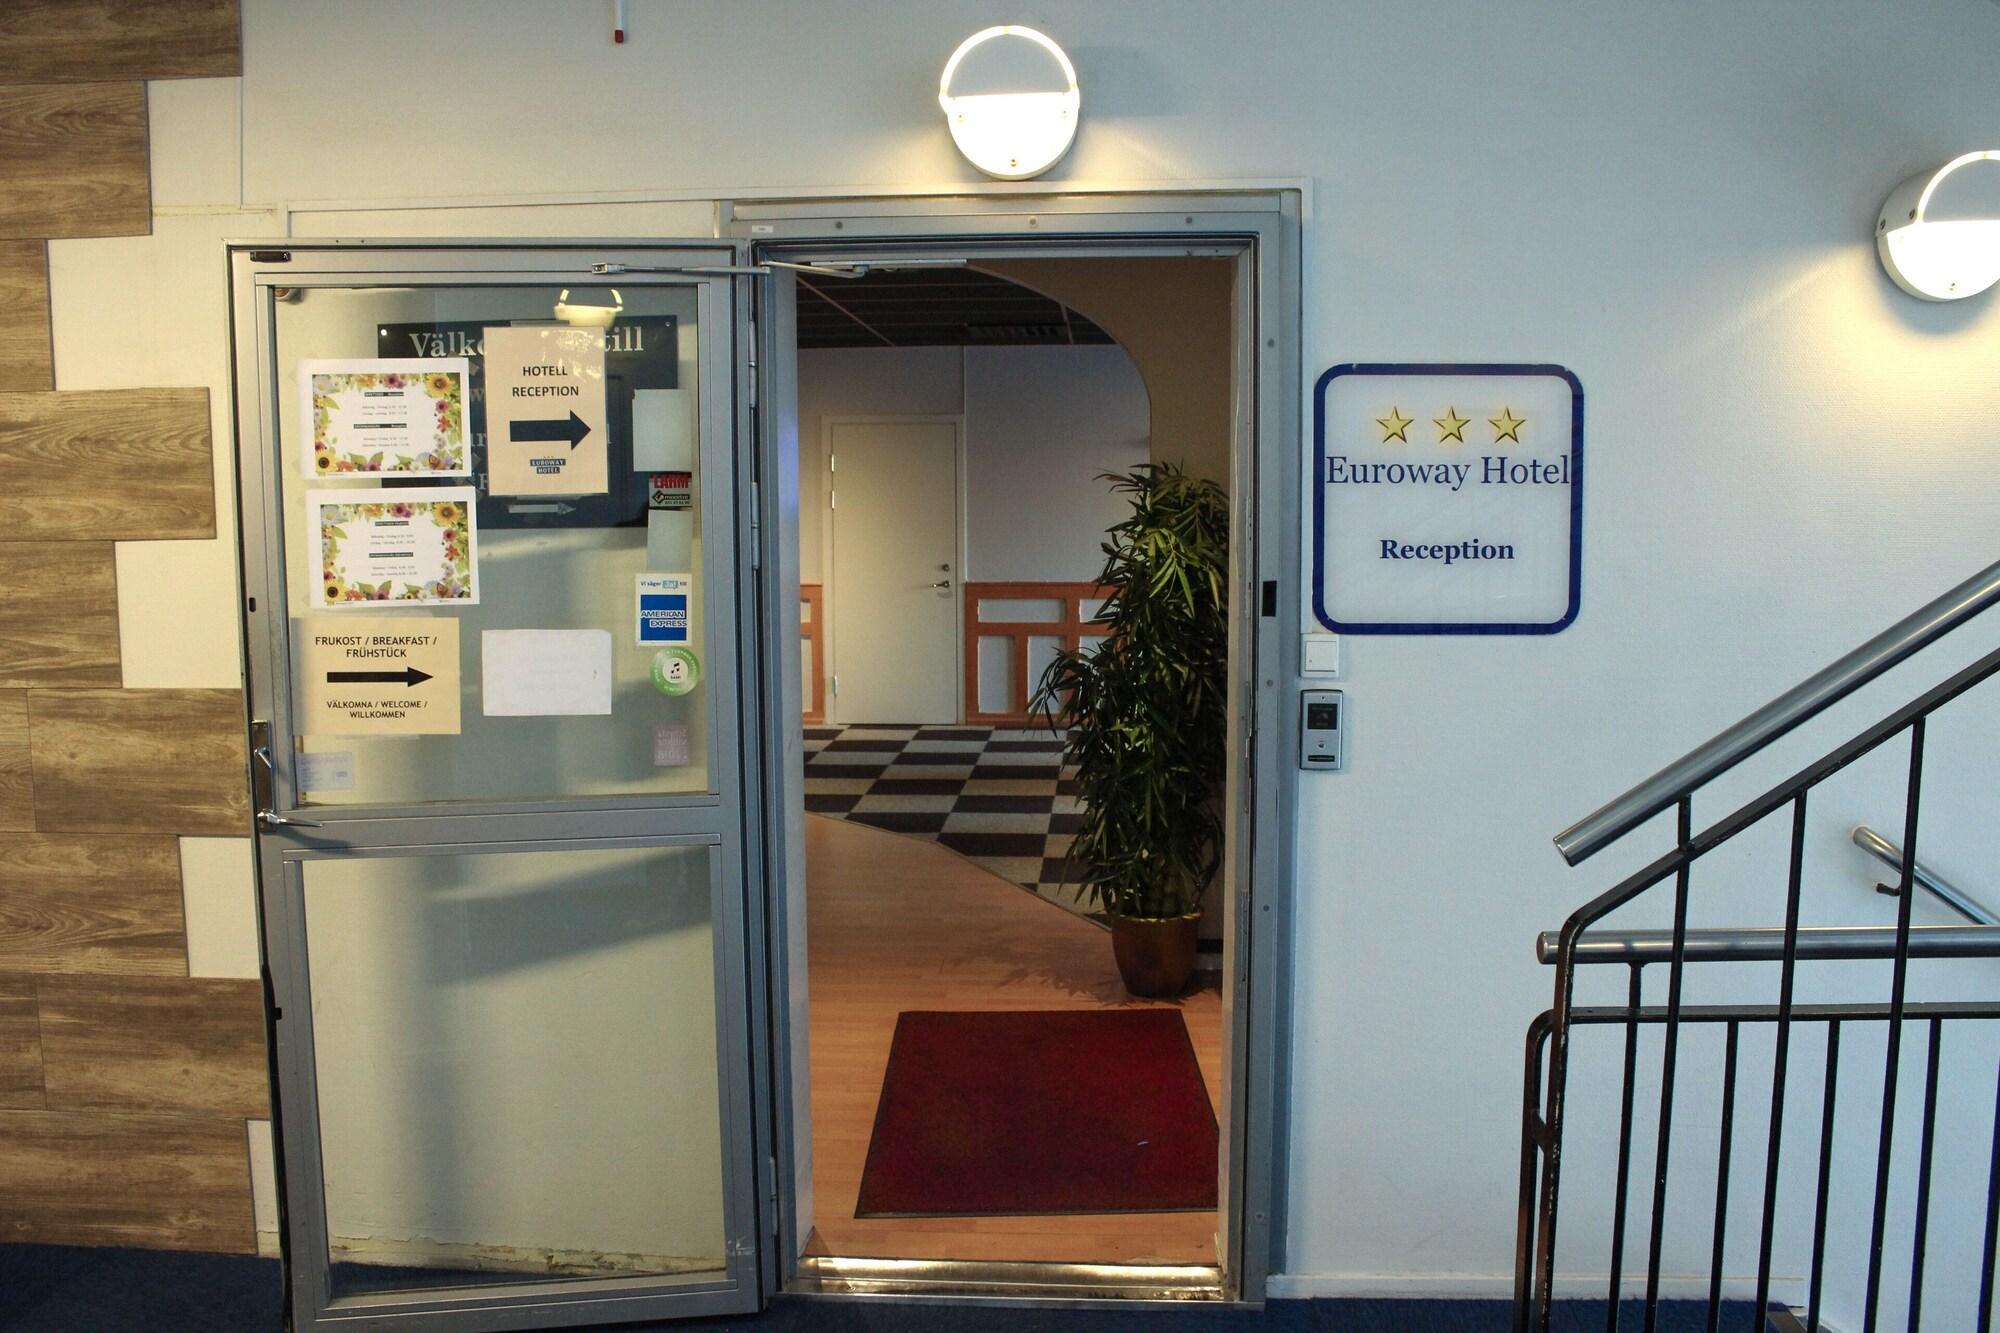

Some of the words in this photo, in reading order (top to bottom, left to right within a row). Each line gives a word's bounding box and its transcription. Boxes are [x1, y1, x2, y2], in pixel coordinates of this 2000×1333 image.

[522, 366, 568, 377] HOTELL
[512, 386, 580, 397] RECEPTION
[1325, 456, 1472, 492] Euroway
[1480, 455, 1571, 485] Hotel
[1379, 538, 1515, 565] Reception
[640, 610, 684, 618] AMERICAN
[315, 636, 362, 646] FRUKOST
[365, 637, 370, 645] /
[372, 636, 430, 646] BREAKFAST
[432, 636, 438, 645] /
[346, 647, 407, 658] FRÜHSTÜCK
[326, 699, 373, 709] VÄLKOMNA
[380, 700, 422, 709] WELCOME
[349, 710, 406, 719] WILLKOMMEN
